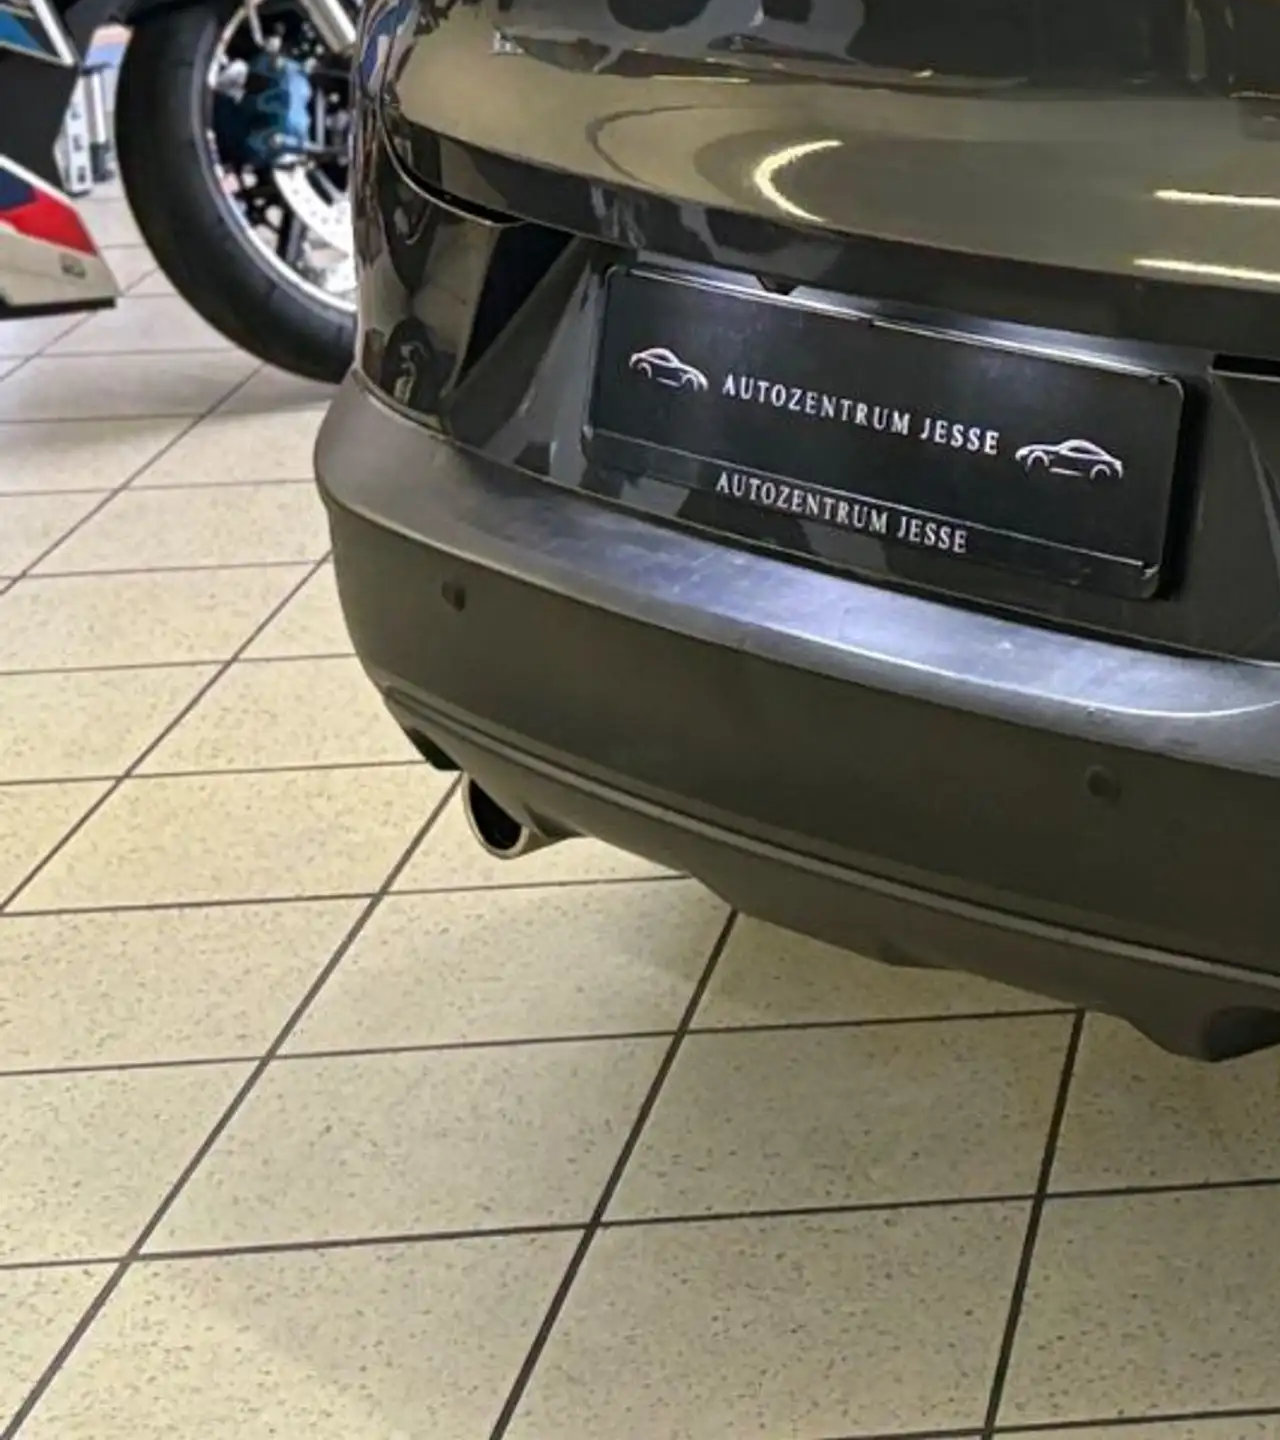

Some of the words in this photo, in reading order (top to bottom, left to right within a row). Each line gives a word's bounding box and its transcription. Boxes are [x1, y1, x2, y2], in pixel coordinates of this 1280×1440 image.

[722, 373, 910, 436] AUTOZENTRUM
[919, 417, 1000, 455] JESSE
[715, 471, 888, 535] AUTOZENTRUM
[896, 515, 968, 553] JESSE
